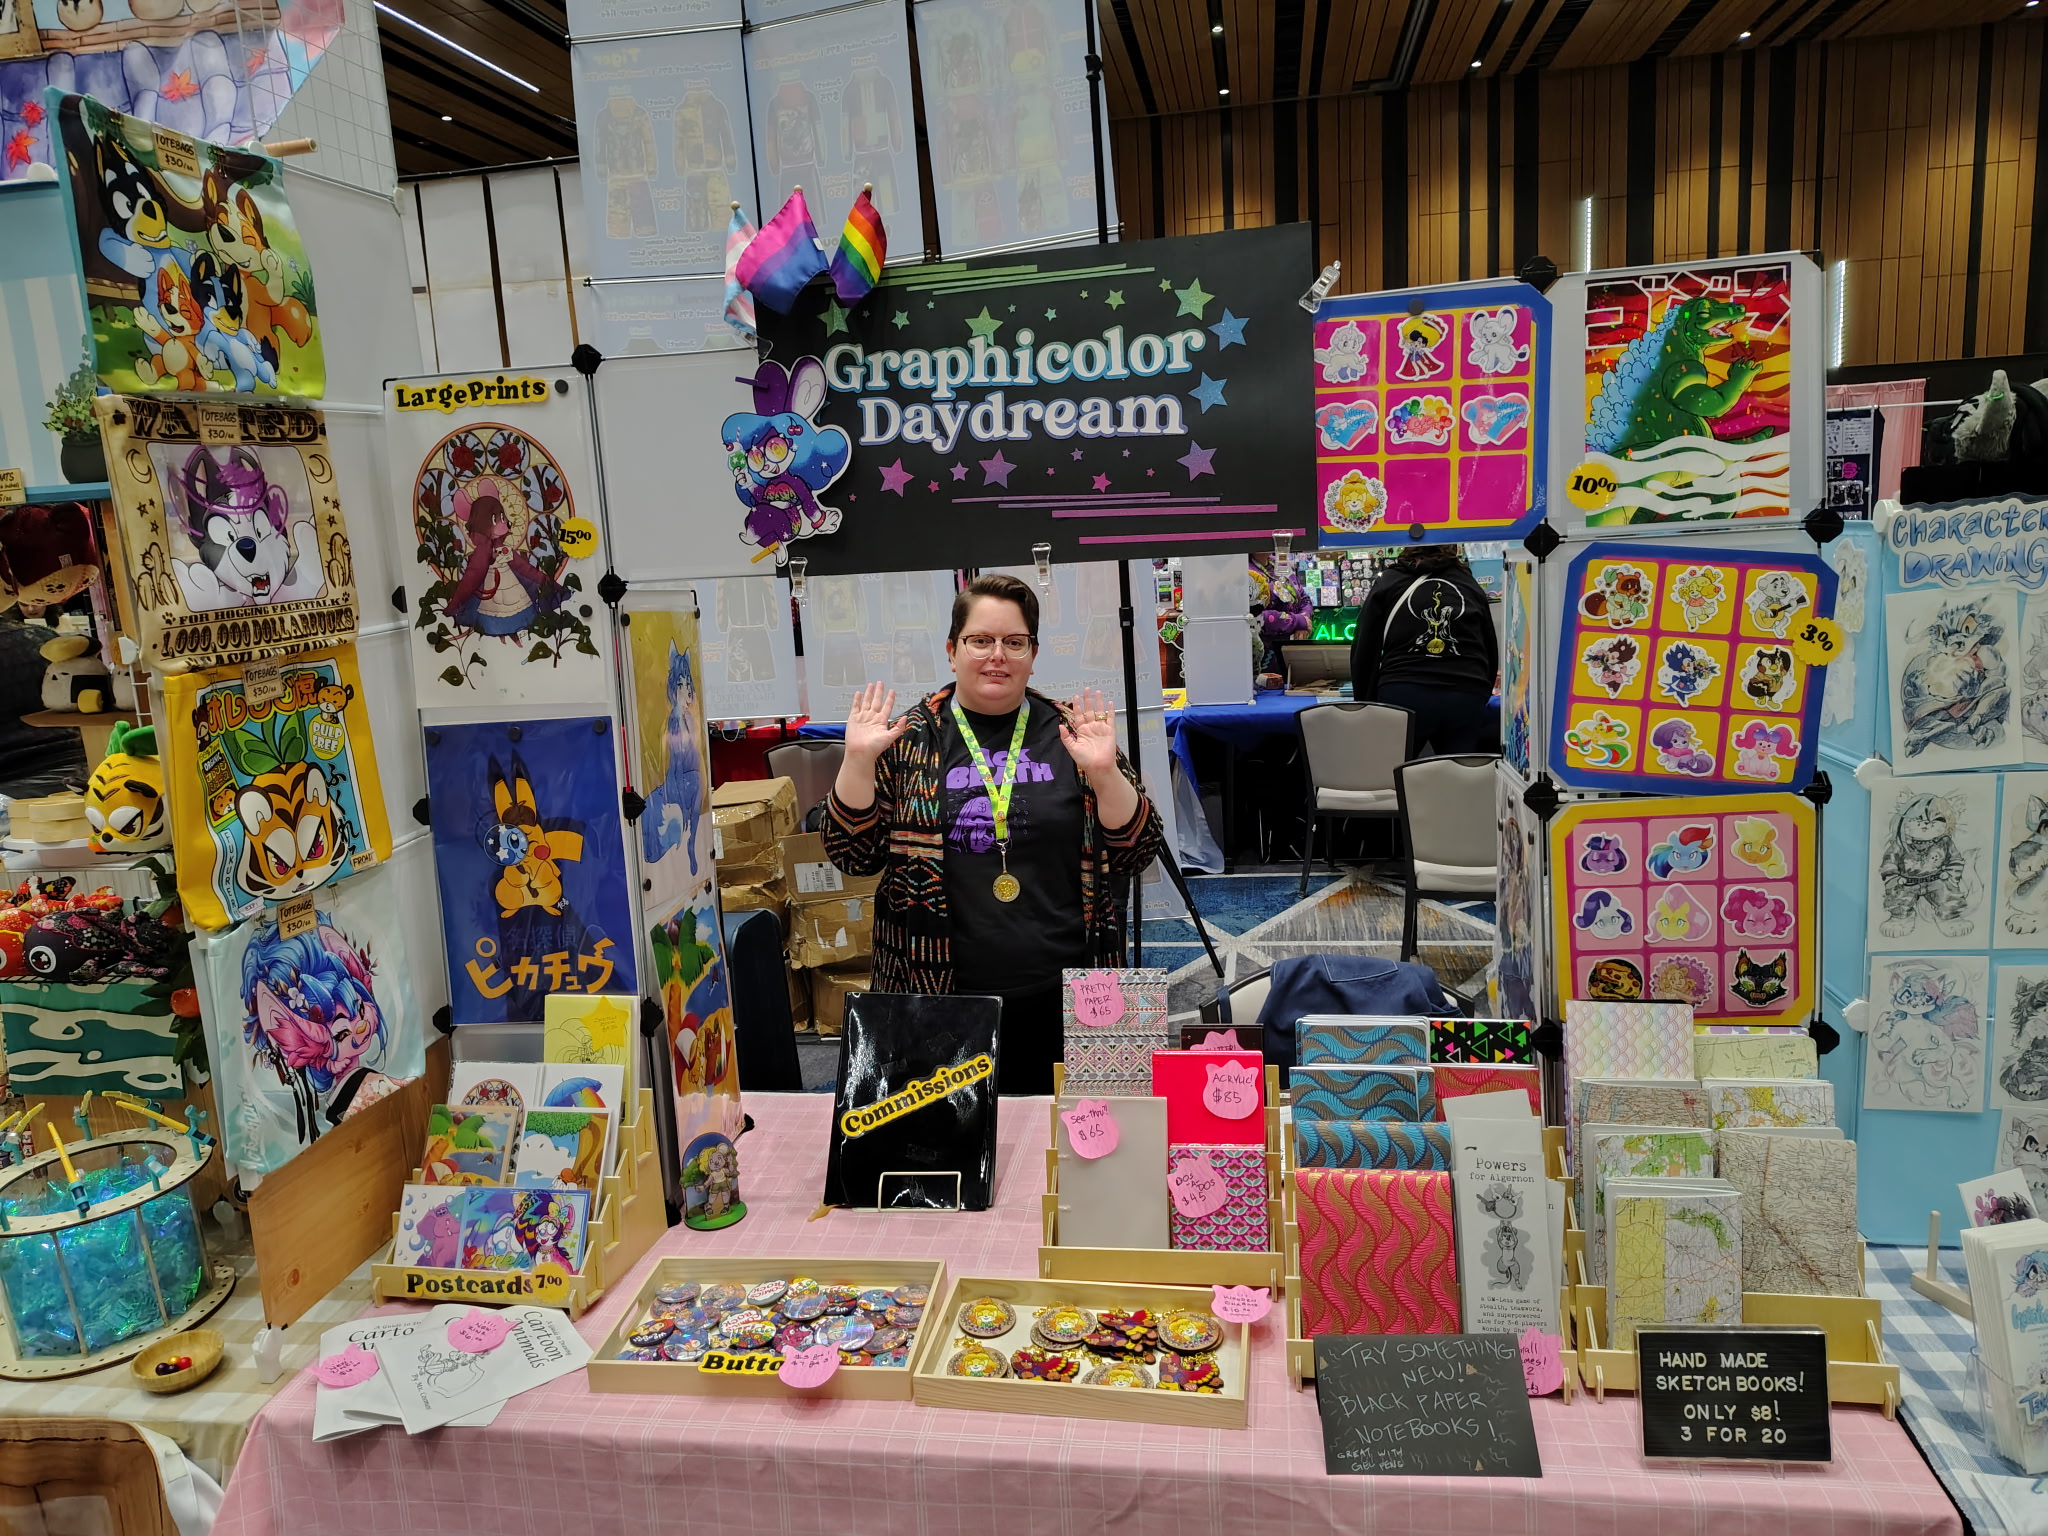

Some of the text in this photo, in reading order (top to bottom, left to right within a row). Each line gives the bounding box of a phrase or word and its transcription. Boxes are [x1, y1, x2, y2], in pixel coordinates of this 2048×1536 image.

[154, 132, 195, 157] TOTEBAGS
[824, 325, 1207, 400] Graphicolor
[122, 398, 320, 444] WATED
[201, 409, 237, 424] TOTEBAGS
[858, 392, 1188, 454] Daydream
[178, 597, 342, 626] FOR HOGGING FACEYTALK
[160, 618, 251, 660] 1,000,000
[251, 606, 356, 644] DOLLARBUCKS
[245, 666, 278, 682] TOTEBAGS
[312, 722, 343, 740] PULP
[312, 736, 340, 753] FREE
[280, 900, 313, 919] TOTEBAGS
[464, 936, 616, 1000] ピカチュウ
[1080, 982, 1113, 994] PRETTY
[1084, 994, 1112, 1006] PAPER
[844, 1057, 990, 1132] Commissions
[1212, 1087, 1242, 1104] $85
[1475, 1157, 1528, 1172] Powers
[1470, 1172, 1535, 1183] for Algernon
[1181, 1191, 1207, 1206] $45
[406, 1273, 534, 1295] Postcards
[1480, 1303, 1508, 1311] stealth,
[1496, 1311, 1542, 1320] superpowered
[1482, 1325, 1511, 1334] Words by
[1521, 1320, 1548, 1328] players
[348, 1326, 415, 1344] Carto
[523, 1311, 565, 1363] Cartoon
[702, 1354, 782, 1372] Butto
[1341, 1339, 1517, 1369] TRY SOMETHING
[1659, 1351, 1769, 1369] HAND MADE
[1402, 1362, 1465, 1389] NEW!
[1338, 1390, 1488, 1419] BLACK PAPER
[1684, 1400, 1782, 1422] ONLY $8!
[1680, 1426, 1788, 1444] 3 FOR 20
[1337, 1448, 1403, 1460] GREAT WITH
[1351, 1460, 1404, 1472] GEL PENS
